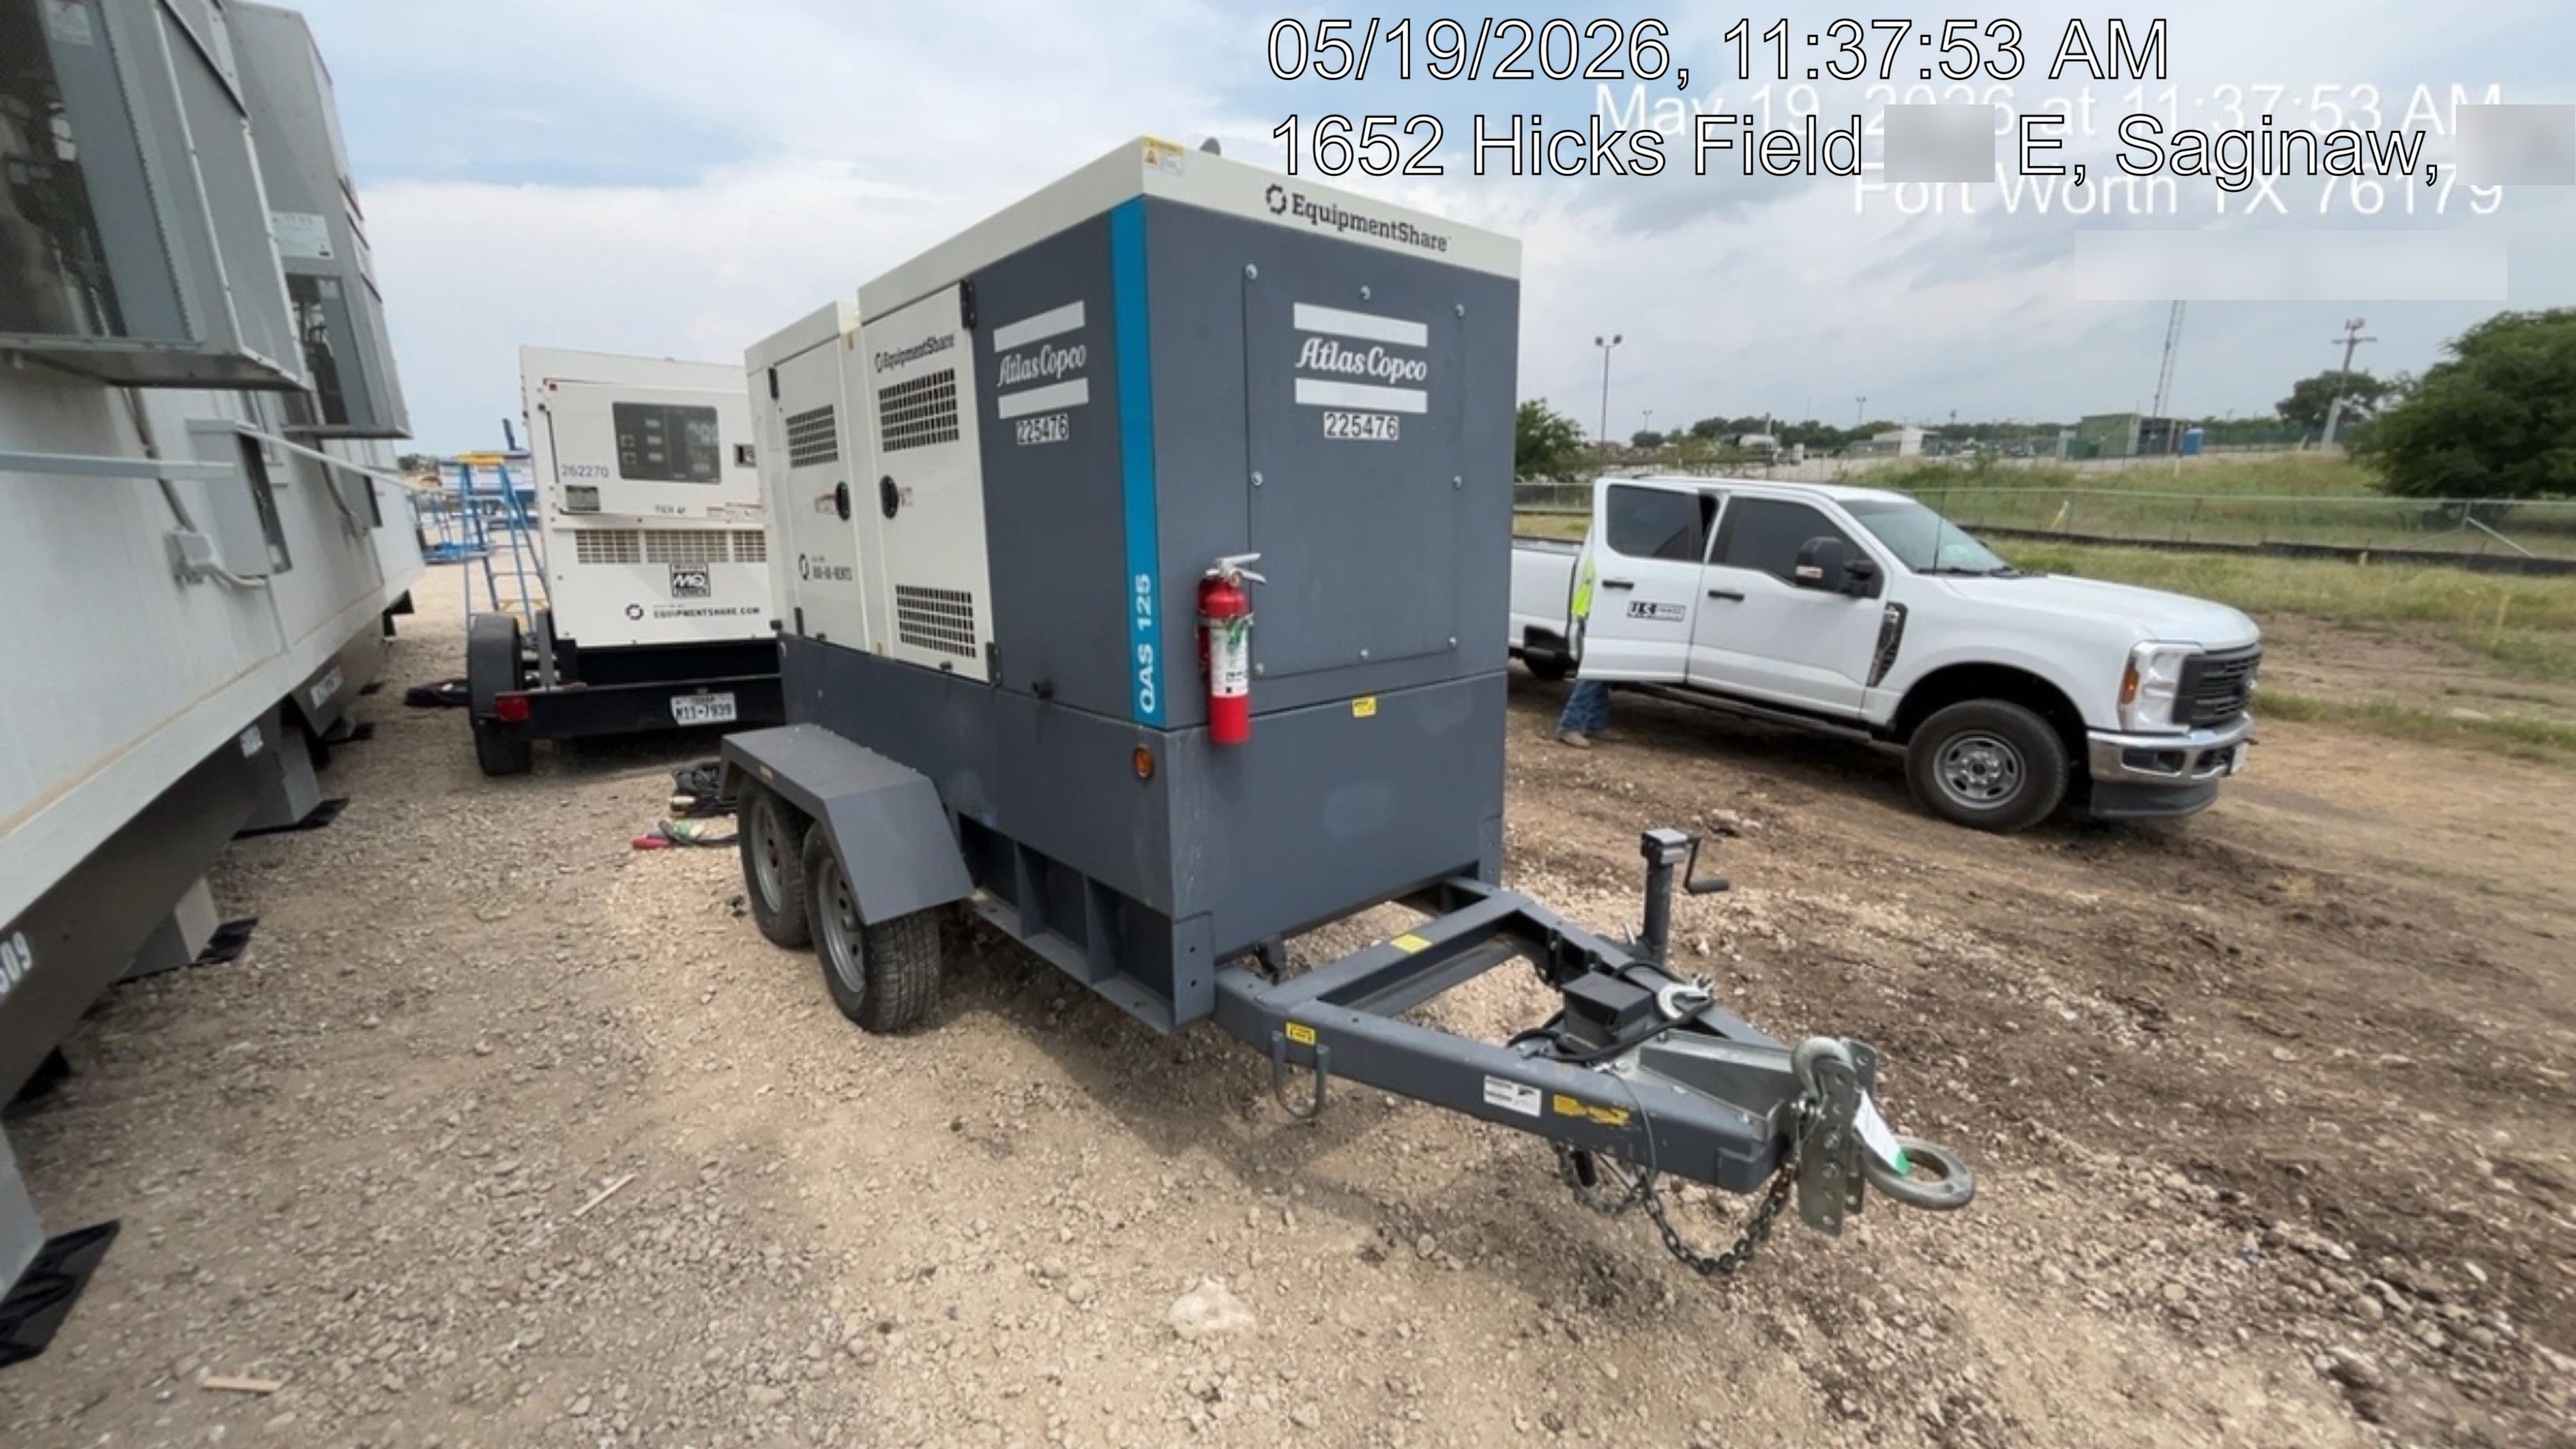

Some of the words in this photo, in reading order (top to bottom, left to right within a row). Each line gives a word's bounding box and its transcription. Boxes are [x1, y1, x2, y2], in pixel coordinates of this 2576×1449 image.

[1292, 193, 1448, 251] EquipmentShare
[1326, 413, 1397, 439] 225476
[1135, 574, 1152, 631] 125
